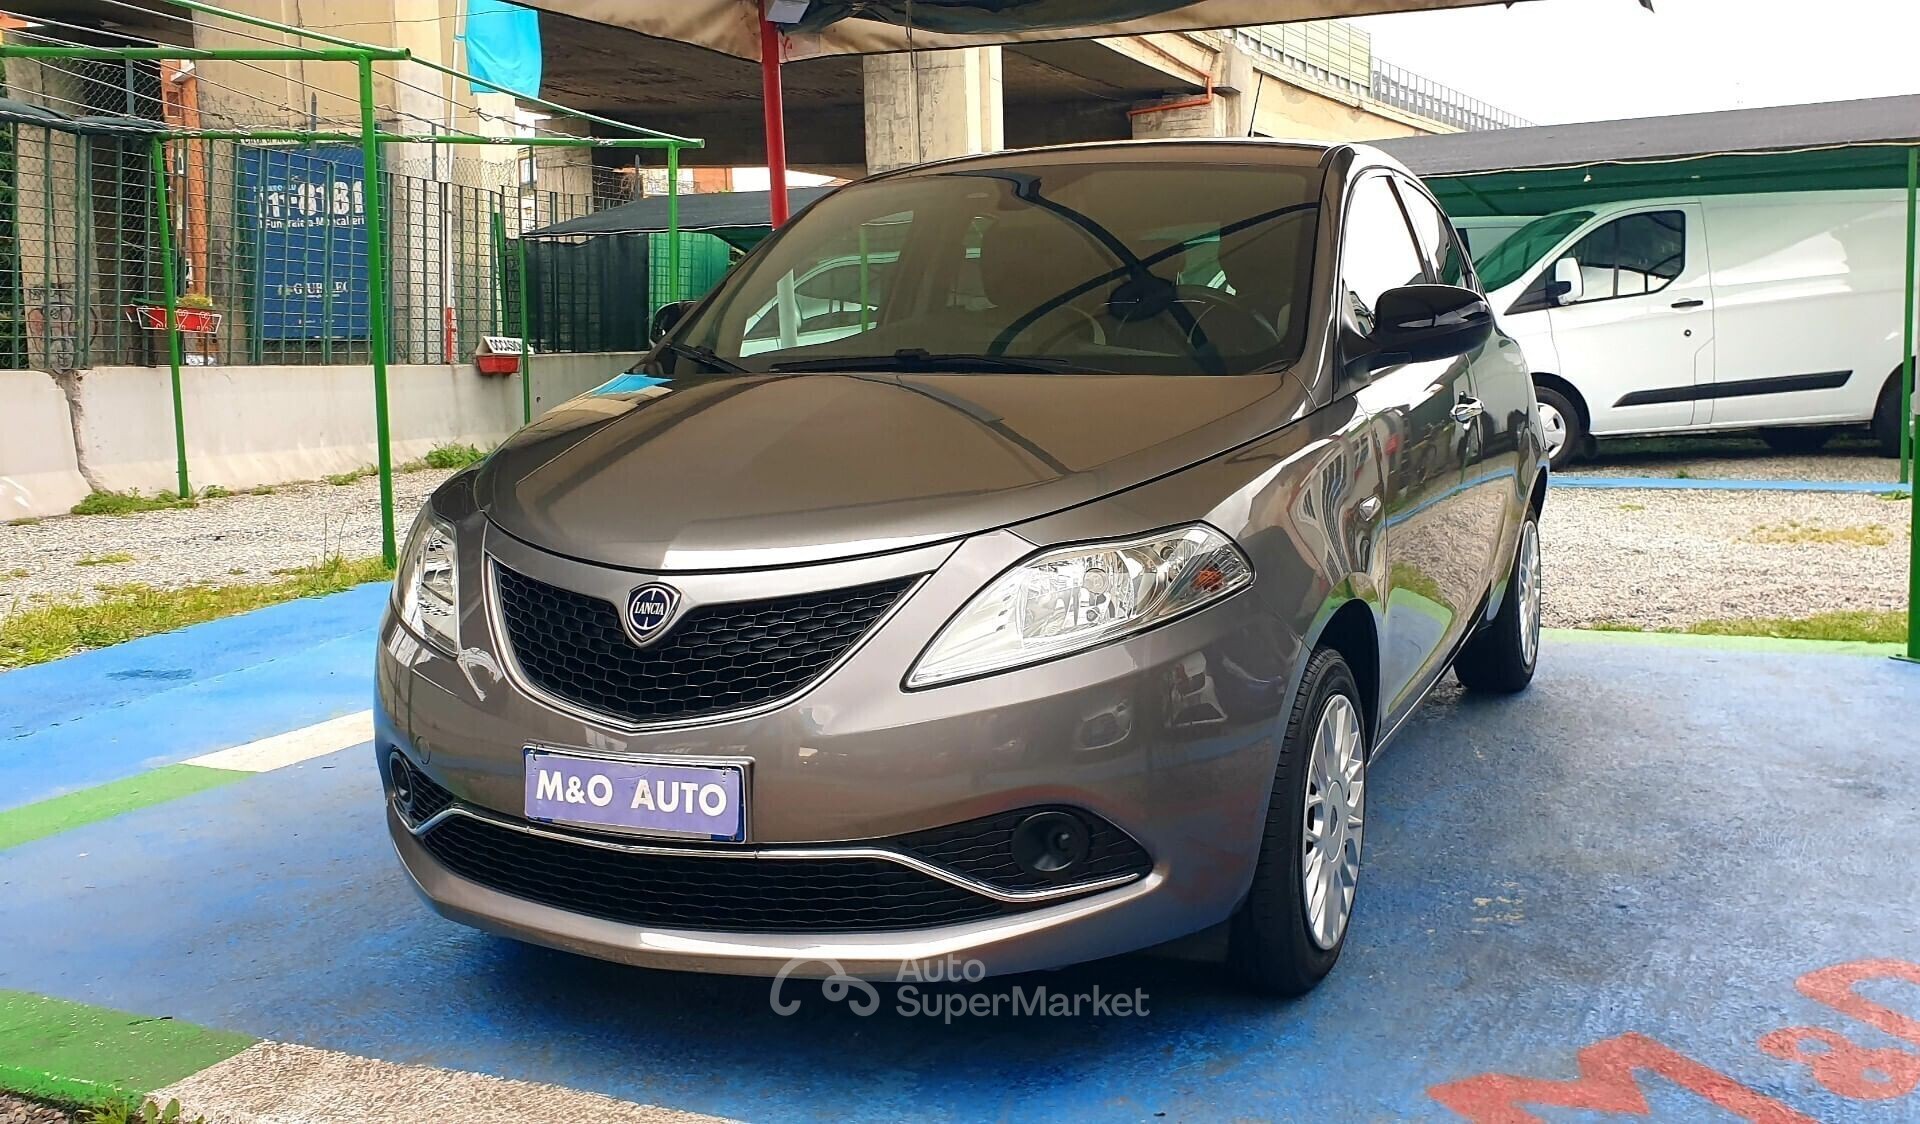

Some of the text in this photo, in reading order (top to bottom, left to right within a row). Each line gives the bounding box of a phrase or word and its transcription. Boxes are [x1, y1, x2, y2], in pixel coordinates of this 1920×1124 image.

[634, 601, 664, 615] LANCIA
[536, 769, 727, 817] M&O AUTO
